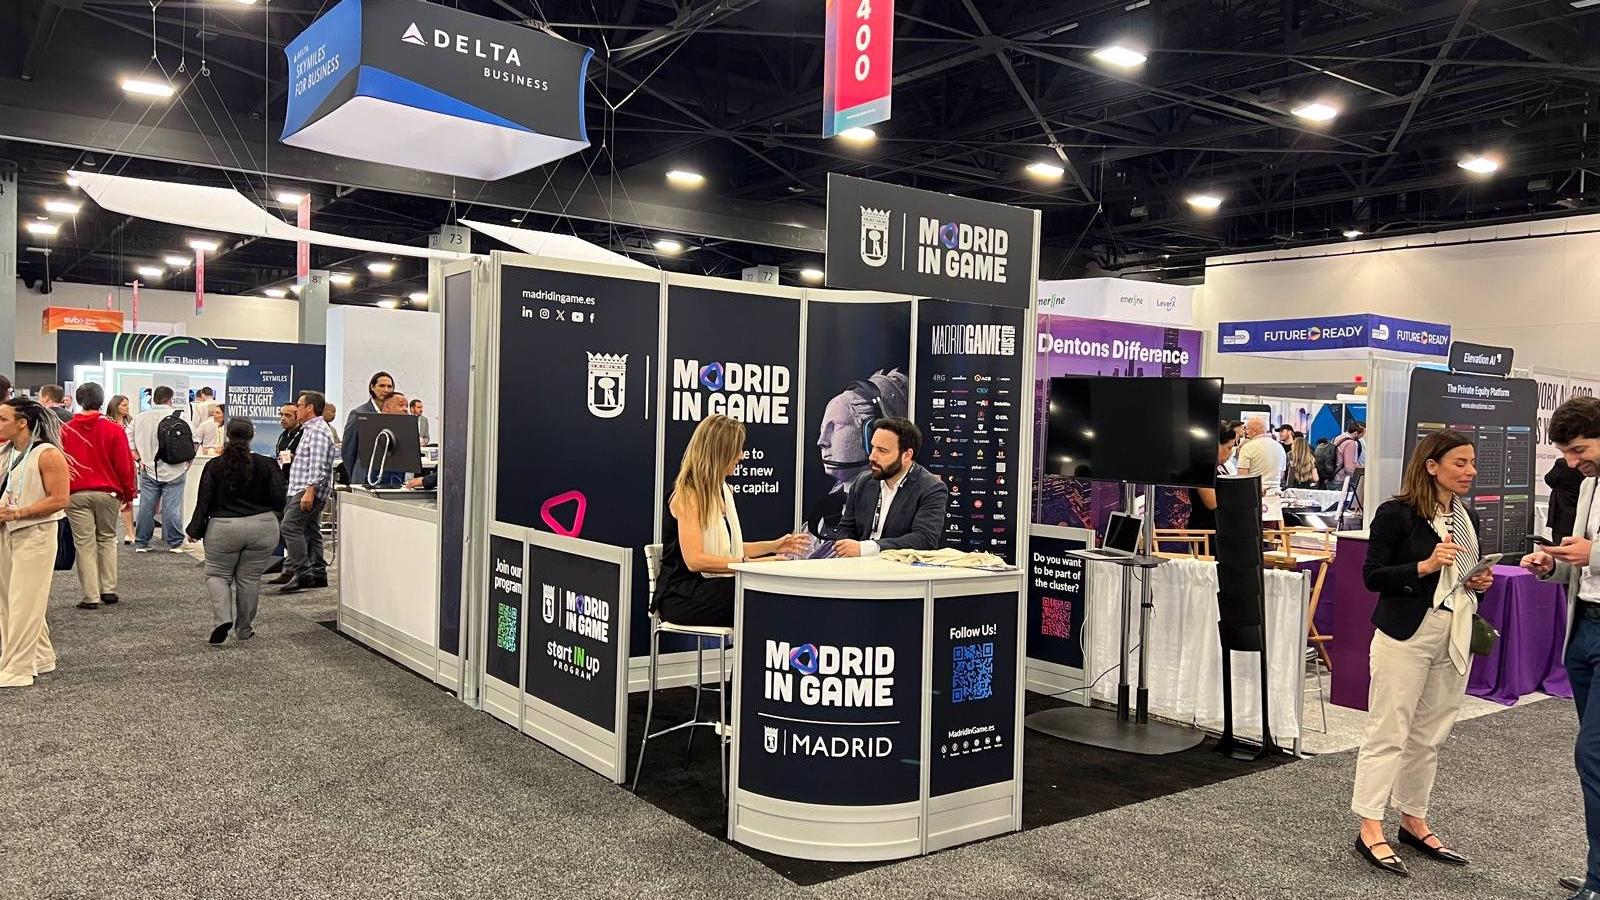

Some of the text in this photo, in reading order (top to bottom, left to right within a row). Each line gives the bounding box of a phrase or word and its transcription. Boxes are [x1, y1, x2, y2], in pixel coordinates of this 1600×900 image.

[434, 29, 521, 67] DELTA
[296, 44, 326, 79] SKYMILES
[295, 54, 340, 98] FOR BUSINESS
[484, 67, 549, 91] BUSINESS
[450, 233, 463, 245] 73
[918, 246, 1008, 284] IN GAME
[522, 290, 595, 305] madridingame.es
[1264, 329, 1307, 341] FUTURE
[1322, 326, 1363, 339] READY
[1397, 330, 1449, 345] FUTURE READY
[1037, 333, 1189, 365] Dentons Difference
[1463, 352, 1489, 365] Elevation
[1447, 384, 1510, 398] The Private Equity Platform
[229, 393, 273, 405] TAKE FLIGHT
[228, 405, 281, 418] WITH SKYMILE
[673, 391, 789, 424] IN GAME
[752, 447, 764, 460] to
[750, 467, 773, 476] new
[742, 481, 779, 495] capital
[1033, 552, 1082, 567] Do you want
[496, 558, 522, 578] Join our
[1034, 565, 1081, 580] to be part of
[1035, 577, 1080, 593] the cluster?
[566, 611, 609, 643] IN GAME
[950, 623, 997, 640] Follow Us!
[553, 659, 592, 681] PROGRAM
[765, 670, 894, 708] IN GAME
[948, 725, 995, 739] MadridInGame.es
[792, 733, 893, 758] MADRID
